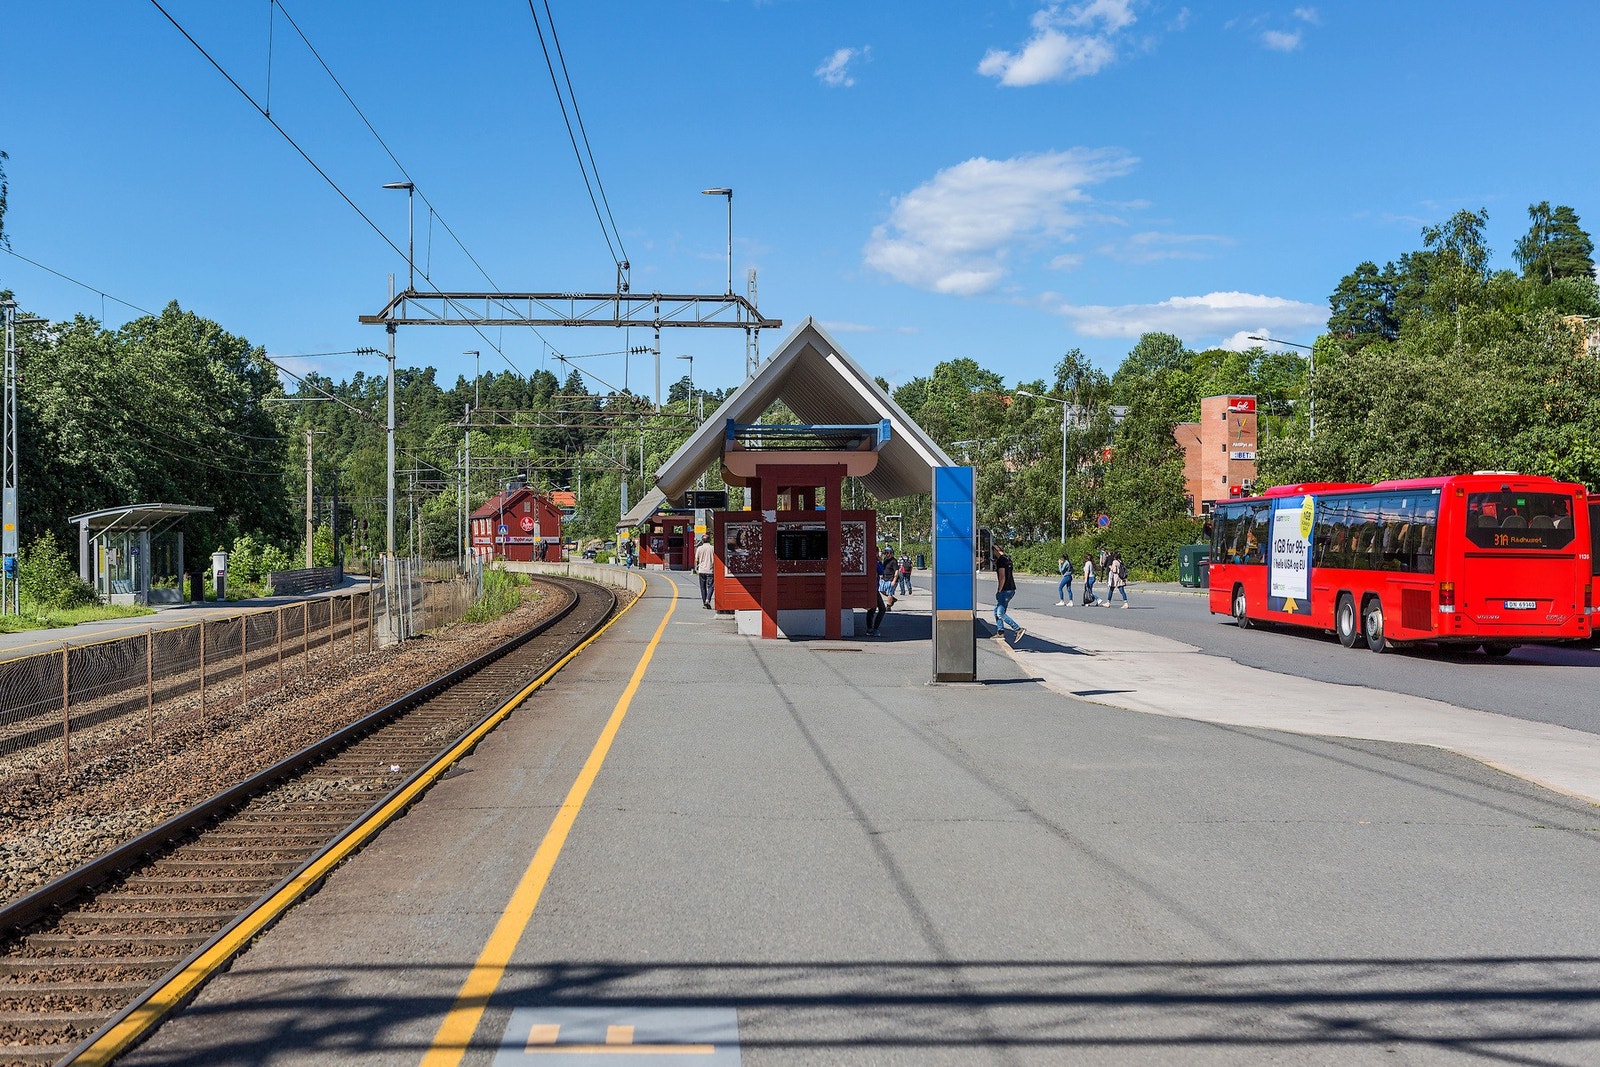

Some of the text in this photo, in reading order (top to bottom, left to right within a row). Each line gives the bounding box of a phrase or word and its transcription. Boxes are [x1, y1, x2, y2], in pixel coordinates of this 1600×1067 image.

[1494, 533, 1509, 546] 31A
[1274, 539, 1306, 557] 1GB for 99,-
[1275, 560, 1284, 569] hele
[1284, 559, 1293, 570] USA
[1293, 563, 1299, 573] og
[1299, 560, 1305, 570] EU
